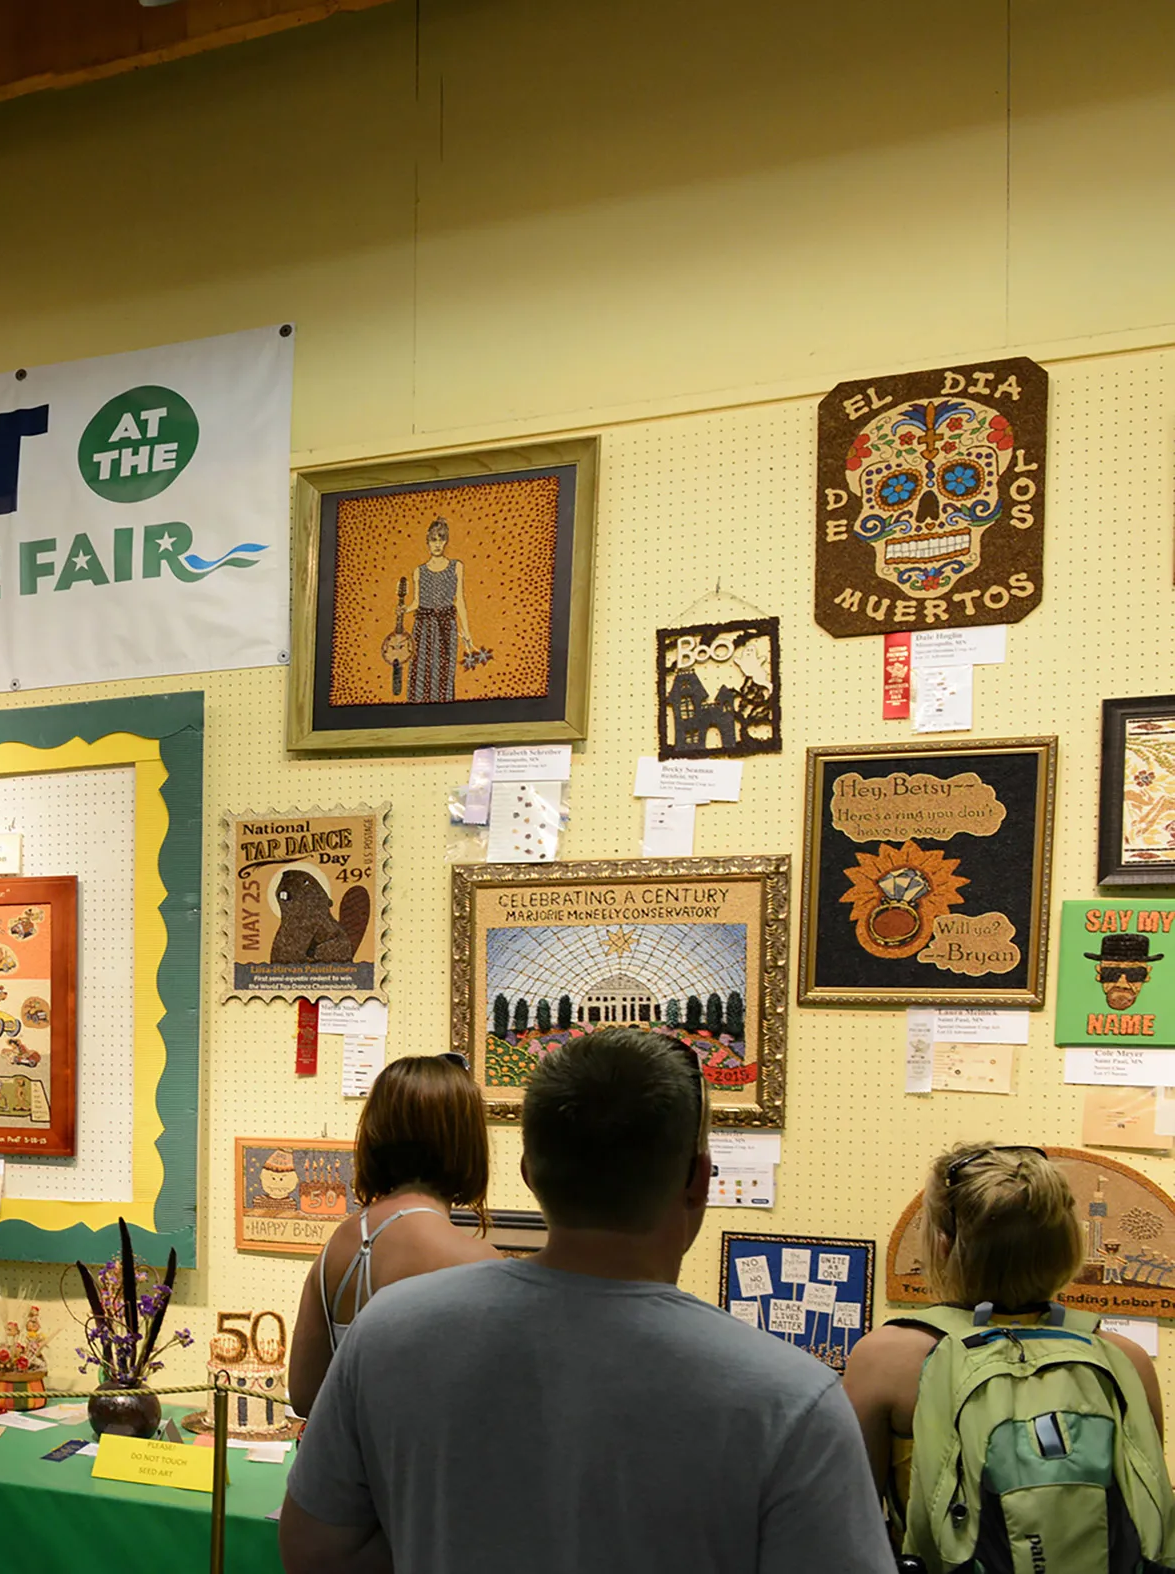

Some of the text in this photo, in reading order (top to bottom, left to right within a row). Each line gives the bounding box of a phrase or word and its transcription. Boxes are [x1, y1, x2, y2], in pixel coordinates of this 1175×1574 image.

[843, 371, 1022, 420] EL DIA
[108, 407, 168, 444] AT
[92, 442, 178, 480] THE
[1009, 449, 1039, 530] LOS
[824, 488, 848, 542] DE
[20, 520, 203, 597] FAIR
[834, 572, 1036, 624] MUERTOS
[840, 779, 888, 800] Hey,
[838, 803, 994, 823] Here's a ring you don't
[242, 821, 311, 836] National
[363, 818, 374, 850] POSTAGE
[857, 823, 890, 837] have
[893, 825, 908, 836] to
[241, 828, 353, 861] TAP DANCE
[318, 852, 351, 866] Day
[335, 865, 372, 884] 49¢
[498, 888, 730, 909] CELEBRATING A CENTURY
[241, 880, 261, 951] MAY 25
[505, 906, 722, 923] MARJORIE McNEELY CONSERVATORY
[1085, 909, 1175, 934] SAY MY
[936, 920, 1002, 937] Will ya?
[1086, 1013, 1156, 1037] NAME
[308, 1190, 337, 1209] 50
[251, 1221, 288, 1237] HAPPY
[742, 1258, 759, 1267] NO
[820, 1256, 847, 1265] UNITE
[749, 1275, 763, 1283] NO
[822, 1270, 844, 1280] ONE
[773, 1302, 803, 1313] BLACK
[1056, 1292, 1108, 1307] Ending
[1113, 1296, 1159, 1308] Labor
[774, 1310, 800, 1321] LIVES
[836, 1316, 856, 1327] ALL
[771, 1320, 803, 1332] MATTER
[216, 1311, 287, 1365] 50
[130, 1452, 187, 1466] DO NOT TOUCH
[138, 1467, 174, 1478] SEED ART
